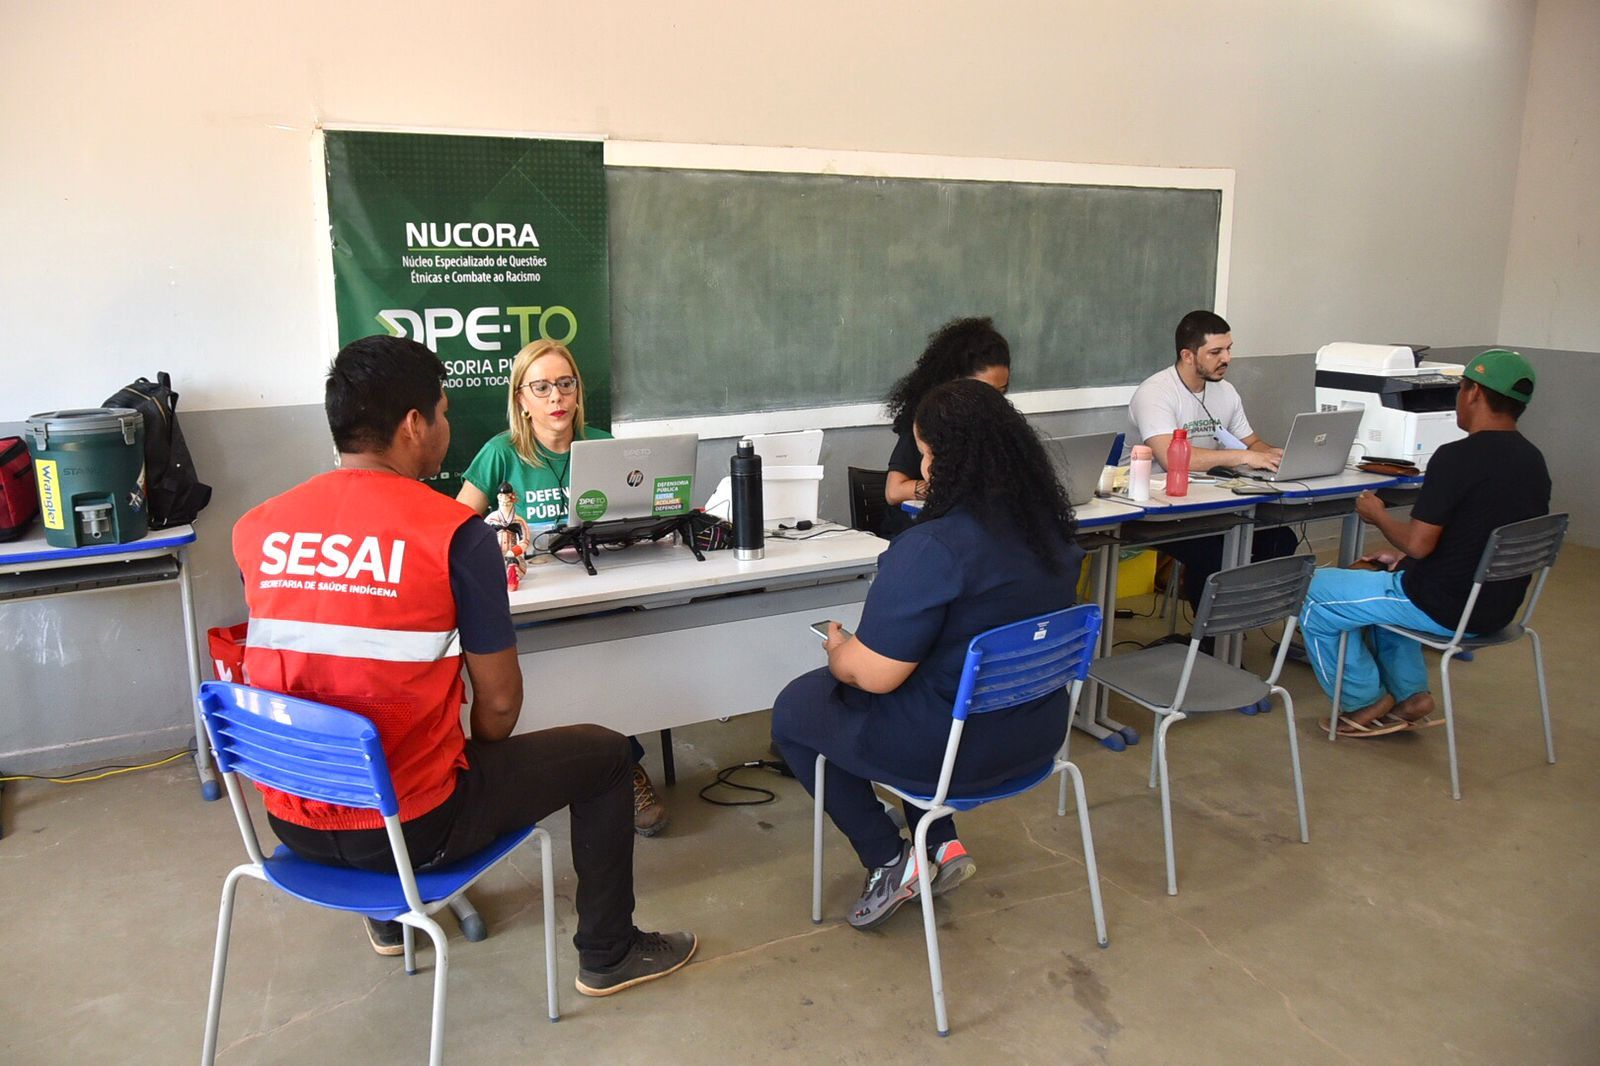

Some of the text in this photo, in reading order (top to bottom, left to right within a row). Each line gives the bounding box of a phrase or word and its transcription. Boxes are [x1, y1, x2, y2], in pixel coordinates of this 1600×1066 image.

[406, 222, 539, 247] NUCORA
[402, 255, 547, 269] Núcleo Especializado de Questões
[410, 269, 541, 284] Étnicas e Combate ao Racismo
[466, 378, 481, 387] DO
[484, 376, 510, 386] TOCA
[627, 470, 644, 488] hp
[41, 465, 56, 525] Wrangler
[260, 531, 406, 585] SESAI
[260, 579, 398, 598] SECRETARIA DE SAÚDE INDÍGENA
[855, 907, 871, 918] FILA
